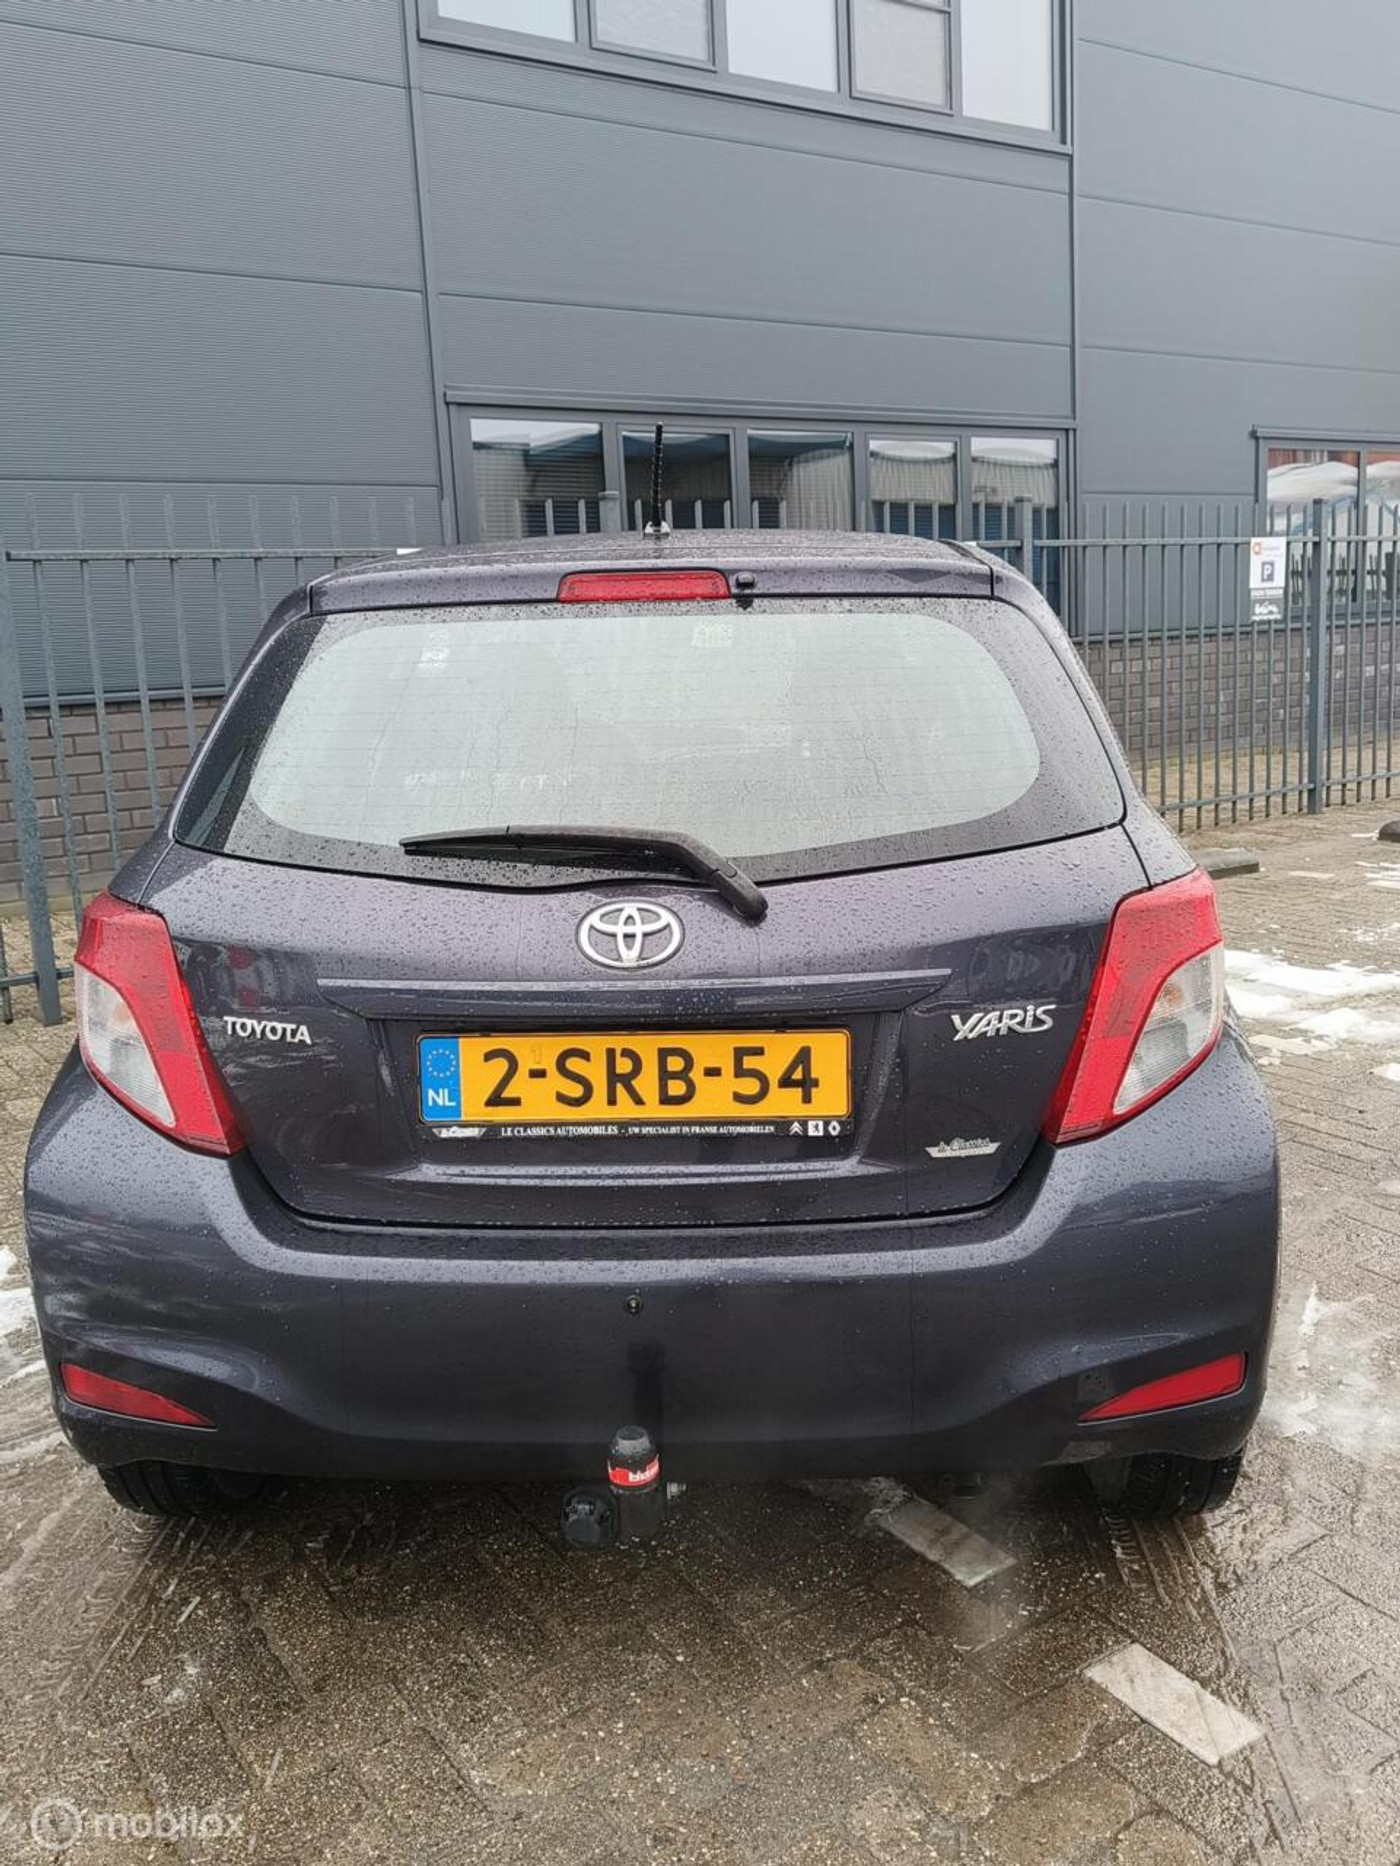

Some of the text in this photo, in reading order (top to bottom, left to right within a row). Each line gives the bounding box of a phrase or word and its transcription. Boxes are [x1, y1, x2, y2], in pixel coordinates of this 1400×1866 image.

[1264, 564, 1272, 579] P
[223, 1016, 312, 1045] TOYOTA
[483, 1045, 819, 1108] 2-SRB-54
[428, 1088, 456, 1107] NL
[501, 1127, 512, 1136] LE
[513, 1126, 555, 1136] CLASSICS
[556, 1125, 618, 1136] AUTOMOBILES
[641, 1126, 680, 1135] SPECIALIST
